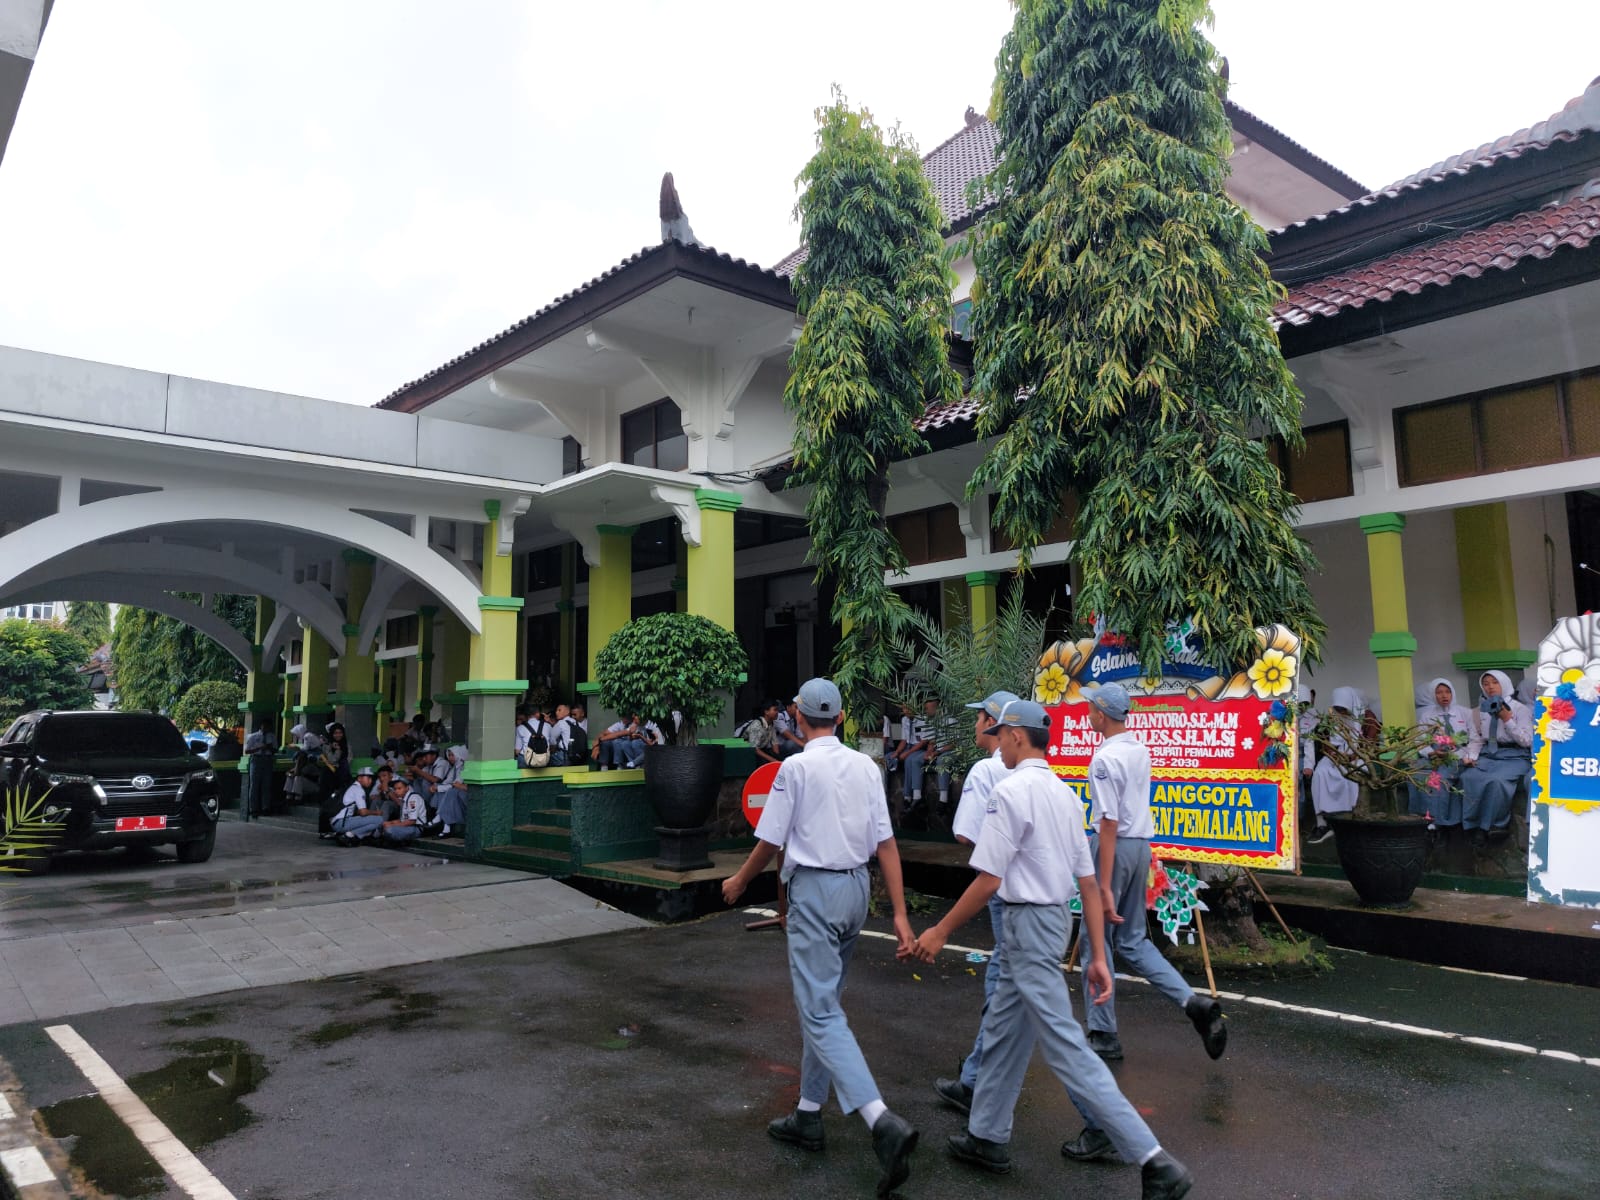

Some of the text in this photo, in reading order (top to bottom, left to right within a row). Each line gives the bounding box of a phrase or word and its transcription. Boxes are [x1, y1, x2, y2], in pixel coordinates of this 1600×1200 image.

[1091, 651, 1142, 679] Selama
[1060, 746, 1093, 757] SEBAGAI
[1184, 747, 1235, 758] PEMALANG
[1151, 758, 1199, 768] 25-2030
[1560, 757, 1600, 777] SEB
[1153, 785, 1253, 807] ANGGOTA
[139, 817, 144, 825] 2
[1172, 808, 1270, 842] PEMALANG
